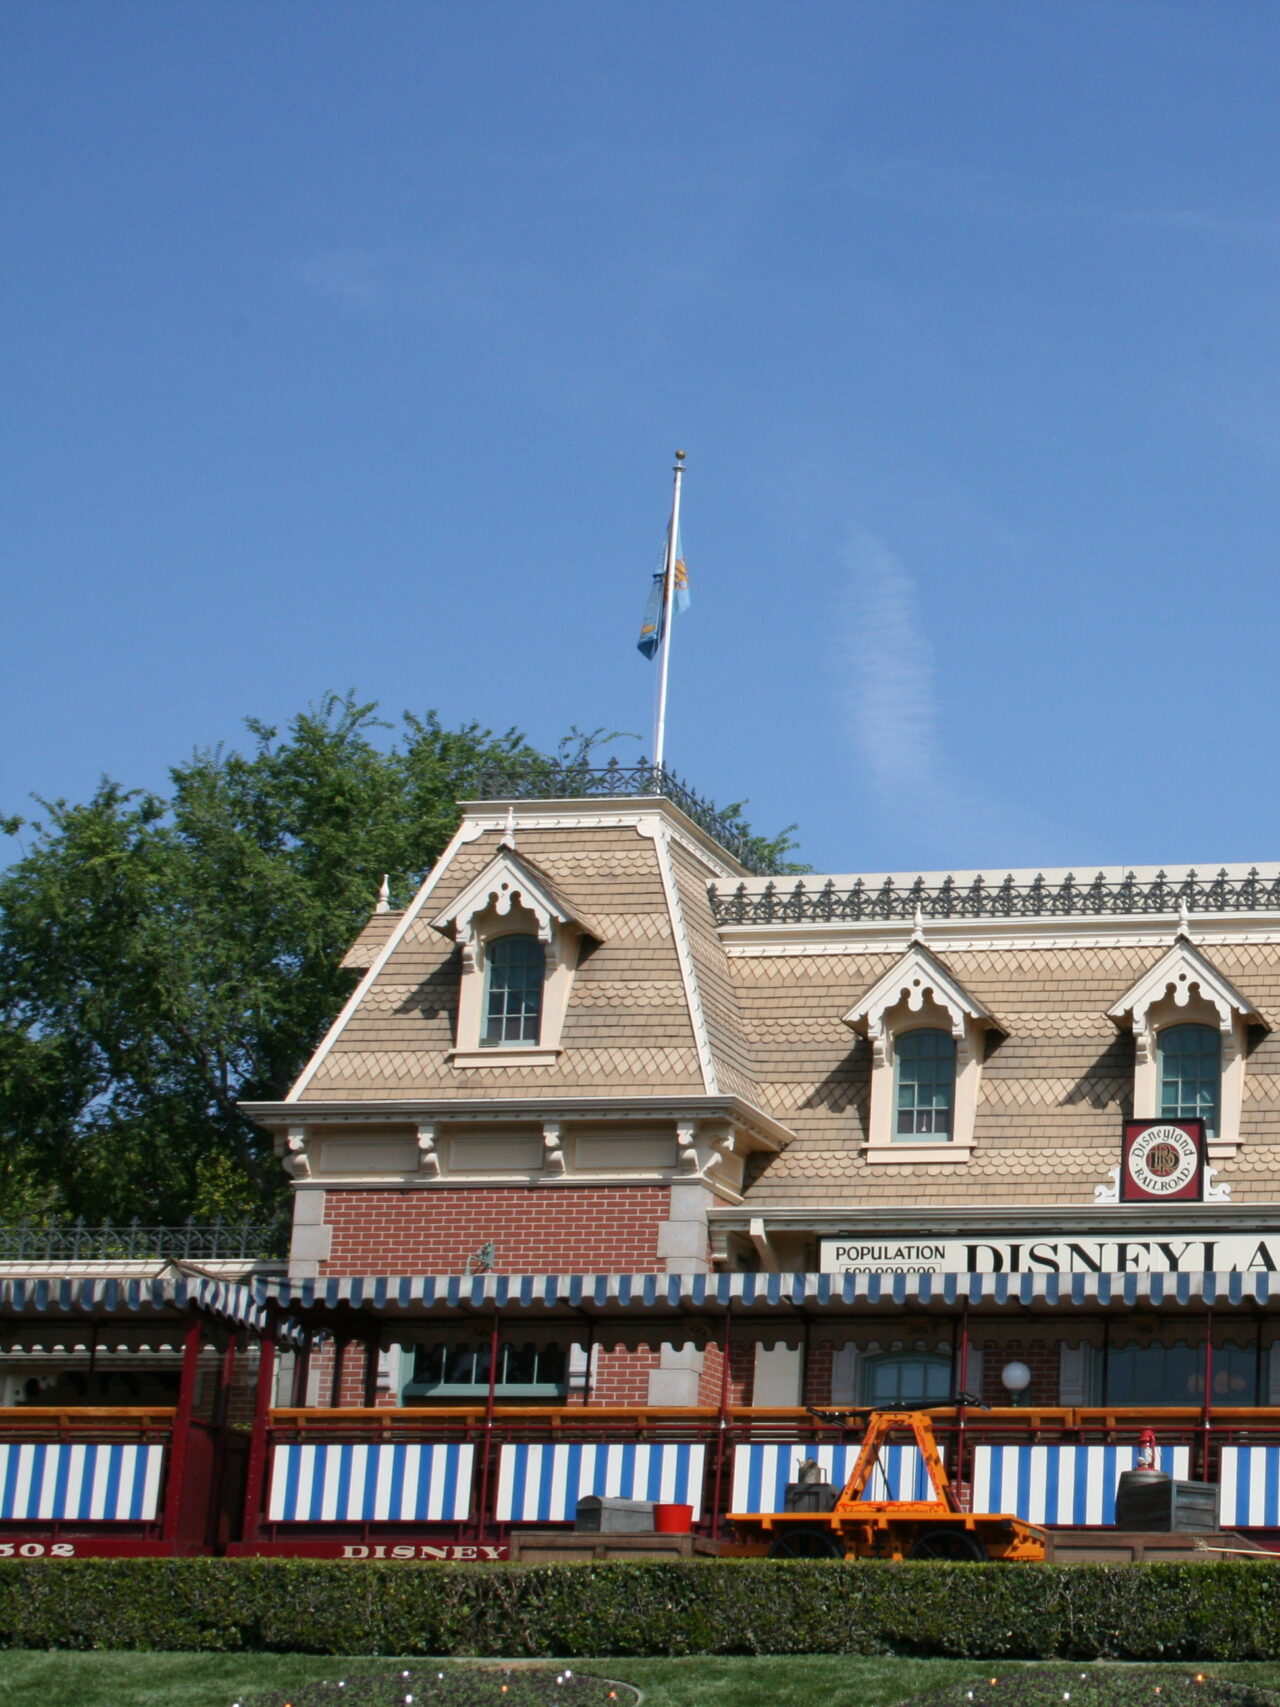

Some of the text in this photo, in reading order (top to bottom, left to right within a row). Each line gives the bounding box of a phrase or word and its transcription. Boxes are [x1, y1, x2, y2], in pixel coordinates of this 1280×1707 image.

[1131, 1128, 1195, 1158] Disneyland
[1135, 1167, 1191, 1191] RAILROAD
[836, 1245, 946, 1260] POPULATION
[0, 1543, 75, 1557] 502
[342, 1545, 508, 1560] DISNEY
